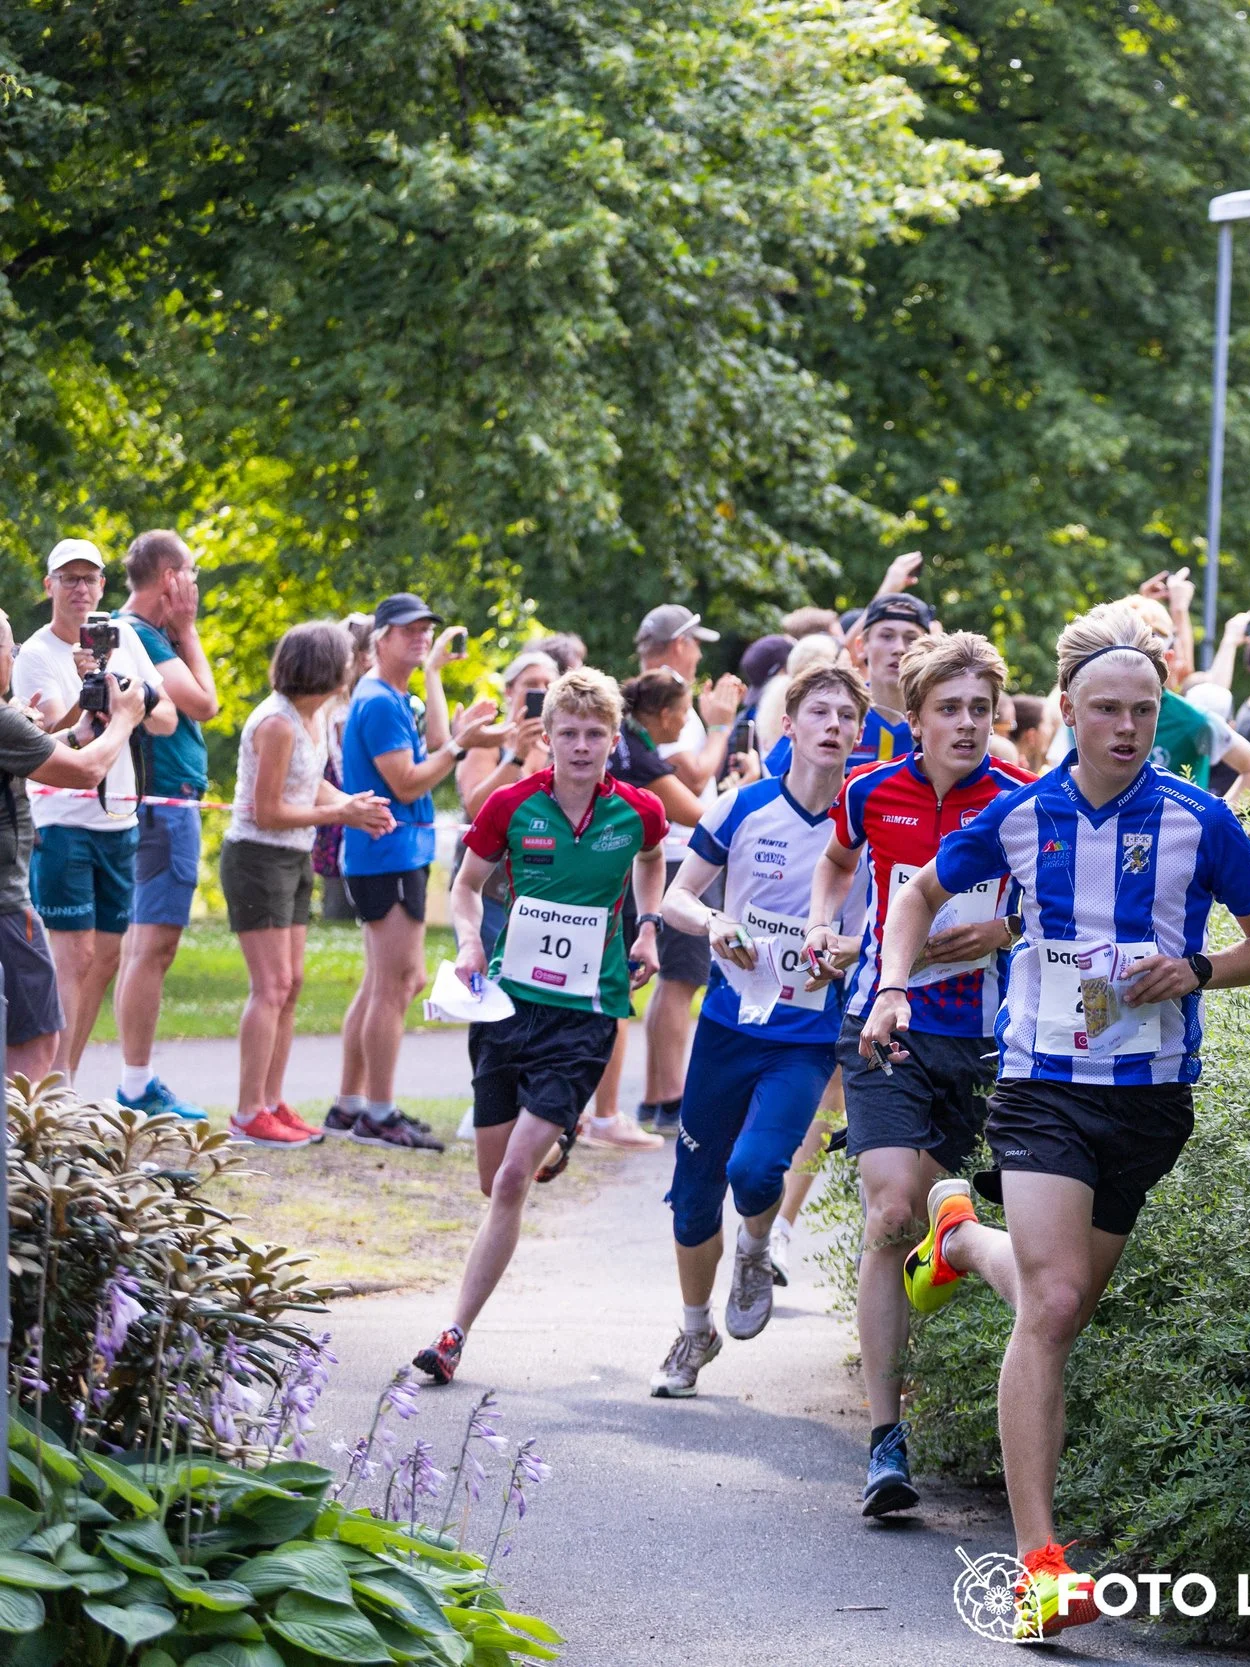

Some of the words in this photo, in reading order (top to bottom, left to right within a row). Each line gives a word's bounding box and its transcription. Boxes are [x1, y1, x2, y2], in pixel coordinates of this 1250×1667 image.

[1117, 771, 1148, 808] noname
[1154, 784, 1206, 813] noname
[881, 814, 919, 826] TRIMTEX
[757, 838, 789, 849] TRIMTEX
[518, 904, 598, 927] bagheera
[539, 934, 572, 959] 10
[581, 963, 589, 974] 1
[1005, 1149, 1028, 1157] CRAFT
